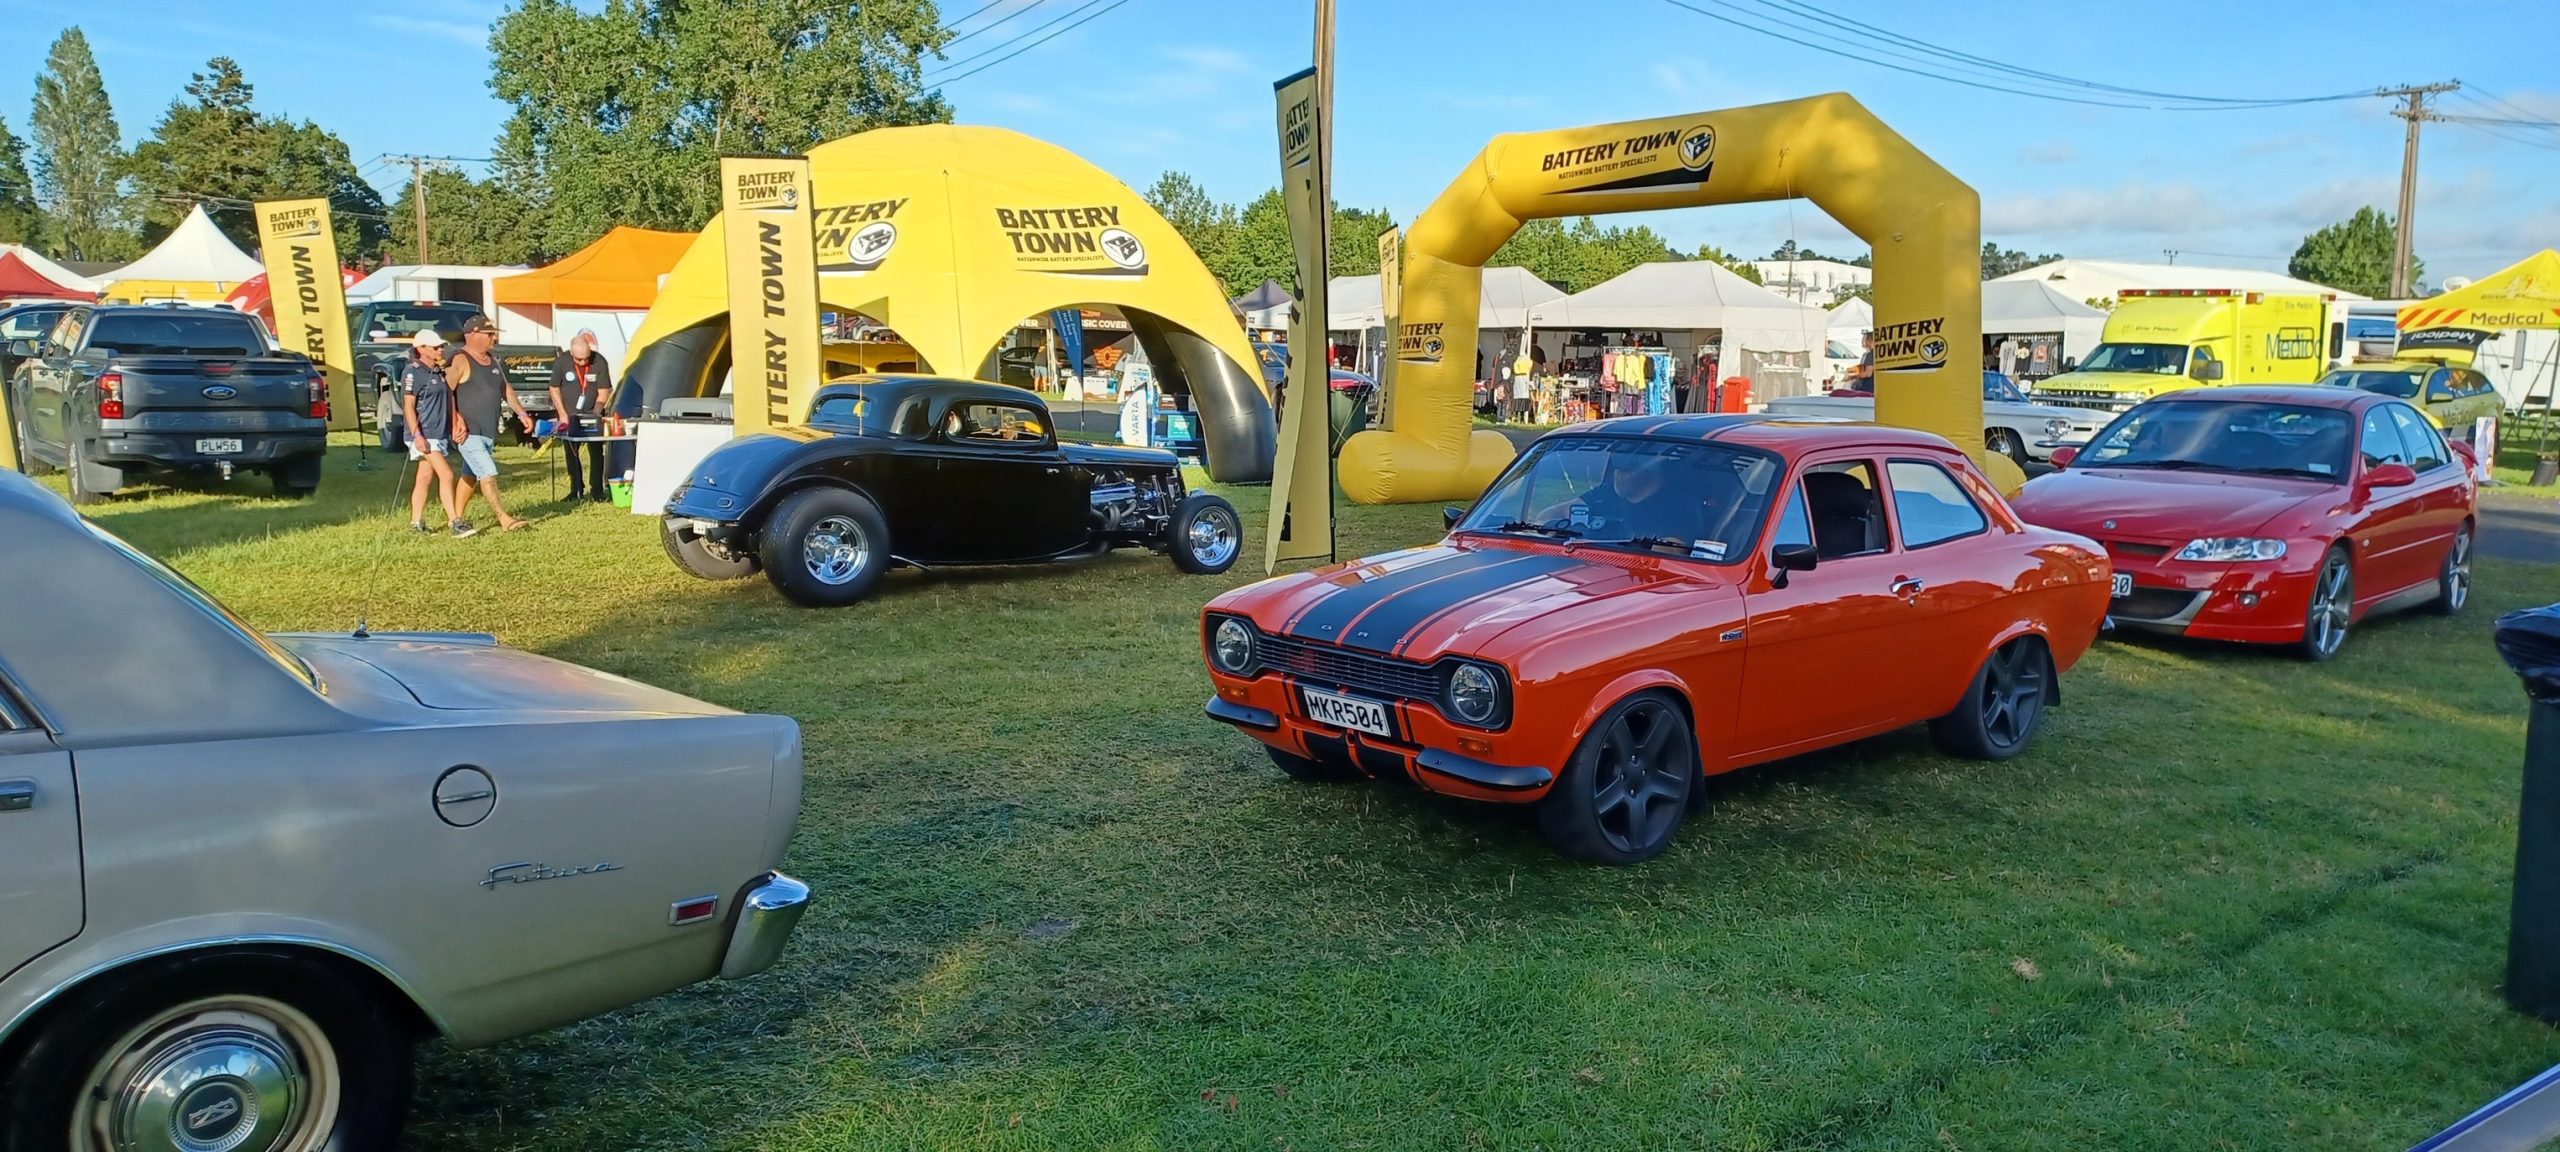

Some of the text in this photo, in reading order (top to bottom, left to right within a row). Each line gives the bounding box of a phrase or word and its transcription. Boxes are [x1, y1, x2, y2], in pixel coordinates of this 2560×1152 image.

[1542, 129, 1682, 172] BATTERY TOWN
[738, 171, 795, 187] BATTERY
[1558, 154, 1658, 181] NATIONWIDE BATTERY SPECIALISTS
[738, 186, 778, 201] TOWN
[269, 207, 317, 223] BATTERY
[814, 198, 910, 226] TTERY
[994, 205, 1121, 230] BATTERY
[271, 218, 305, 233] TOWN
[1006, 231, 1097, 254] TOWN
[290, 245, 320, 315] TOWN
[758, 220, 785, 318] TOWN
[1098, 320, 1127, 329] COVER
[1874, 317, 1945, 342] BATTERY
[2470, 311, 2544, 326] Medical
[2411, 330, 2476, 341] Medical
[1875, 339, 1916, 359] TOWN
[764, 328, 789, 426] TTERY
[1131, 401, 1140, 436] VARTA
[201, 440, 237, 451] PLW56
[1307, 694, 1384, 731] MKR504
[479, 862, 625, 891] Futura
